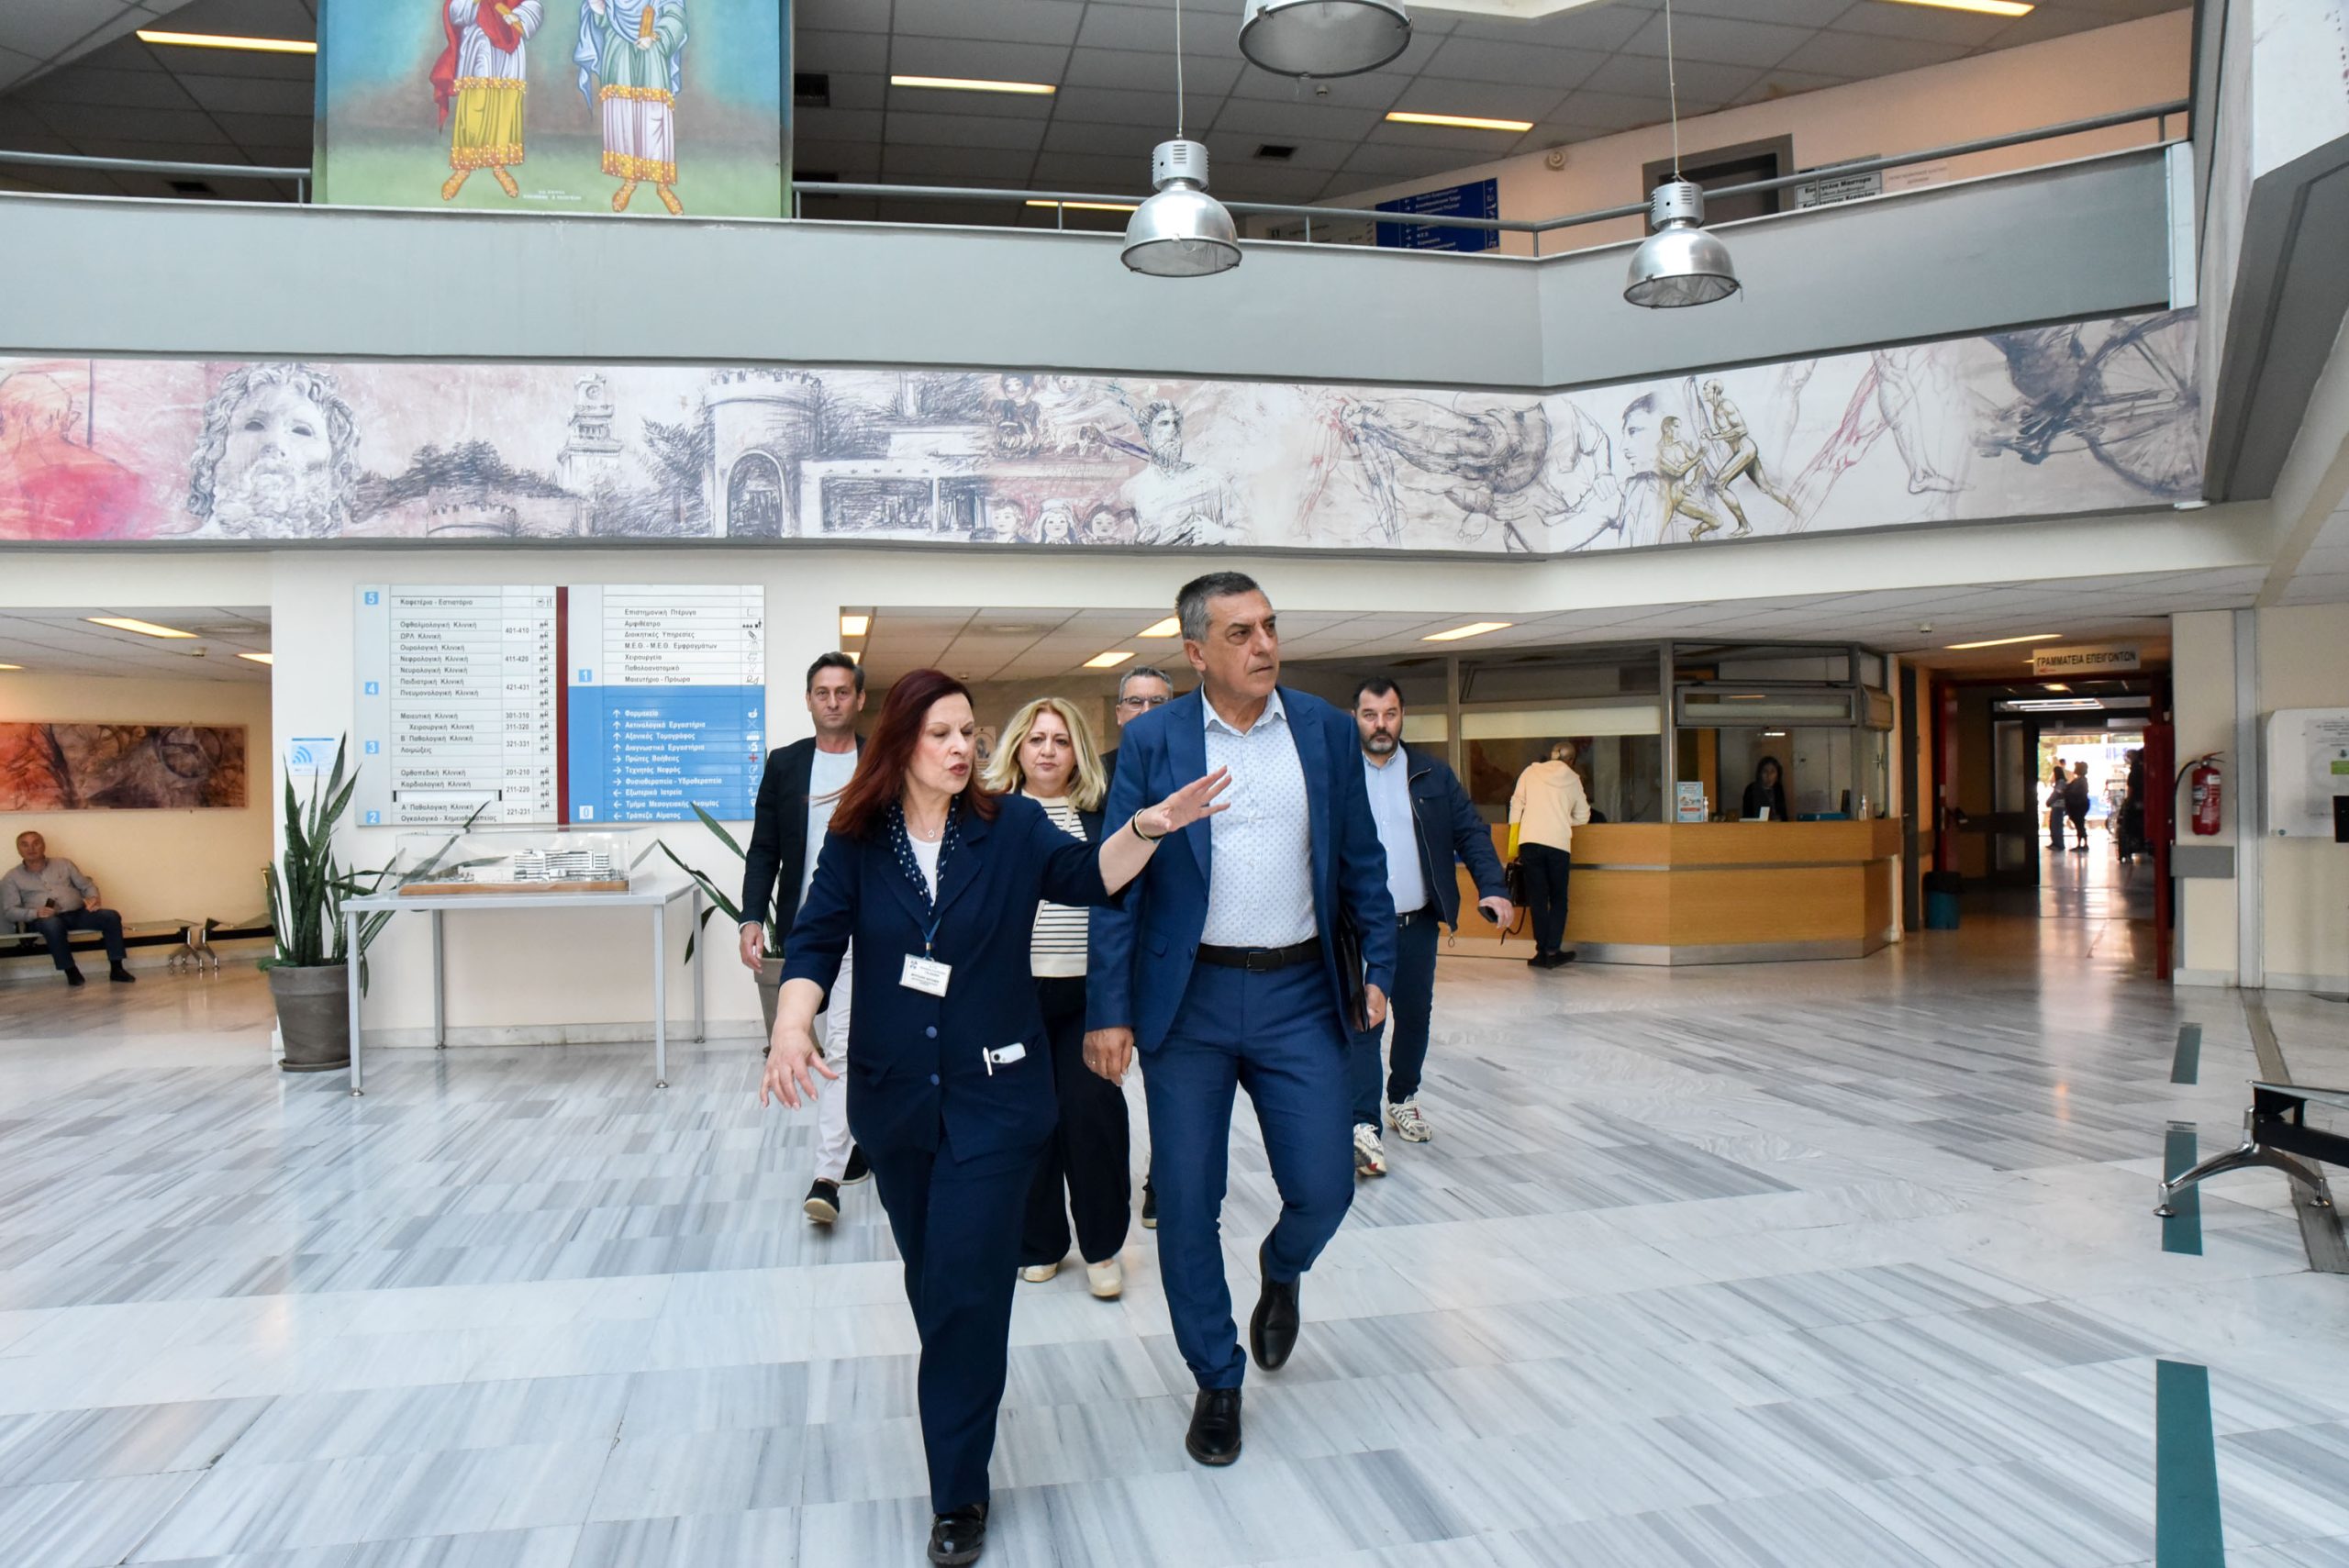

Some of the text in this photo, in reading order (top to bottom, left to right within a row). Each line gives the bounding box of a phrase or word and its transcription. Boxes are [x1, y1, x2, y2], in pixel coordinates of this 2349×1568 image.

[453, 621, 477, 629] Κλινική
[445, 655, 469, 663] Κλινική
[2037, 654, 2084, 667] ΓΡΑΜΜΑΤΕΙΑ
[440, 678, 464, 686] Κλινική
[455, 690, 479, 698] Κλινική
[450, 735, 473, 743] Κλινική
[442, 770, 466, 778] Κλινική
[448, 781, 472, 789] Κλινική
